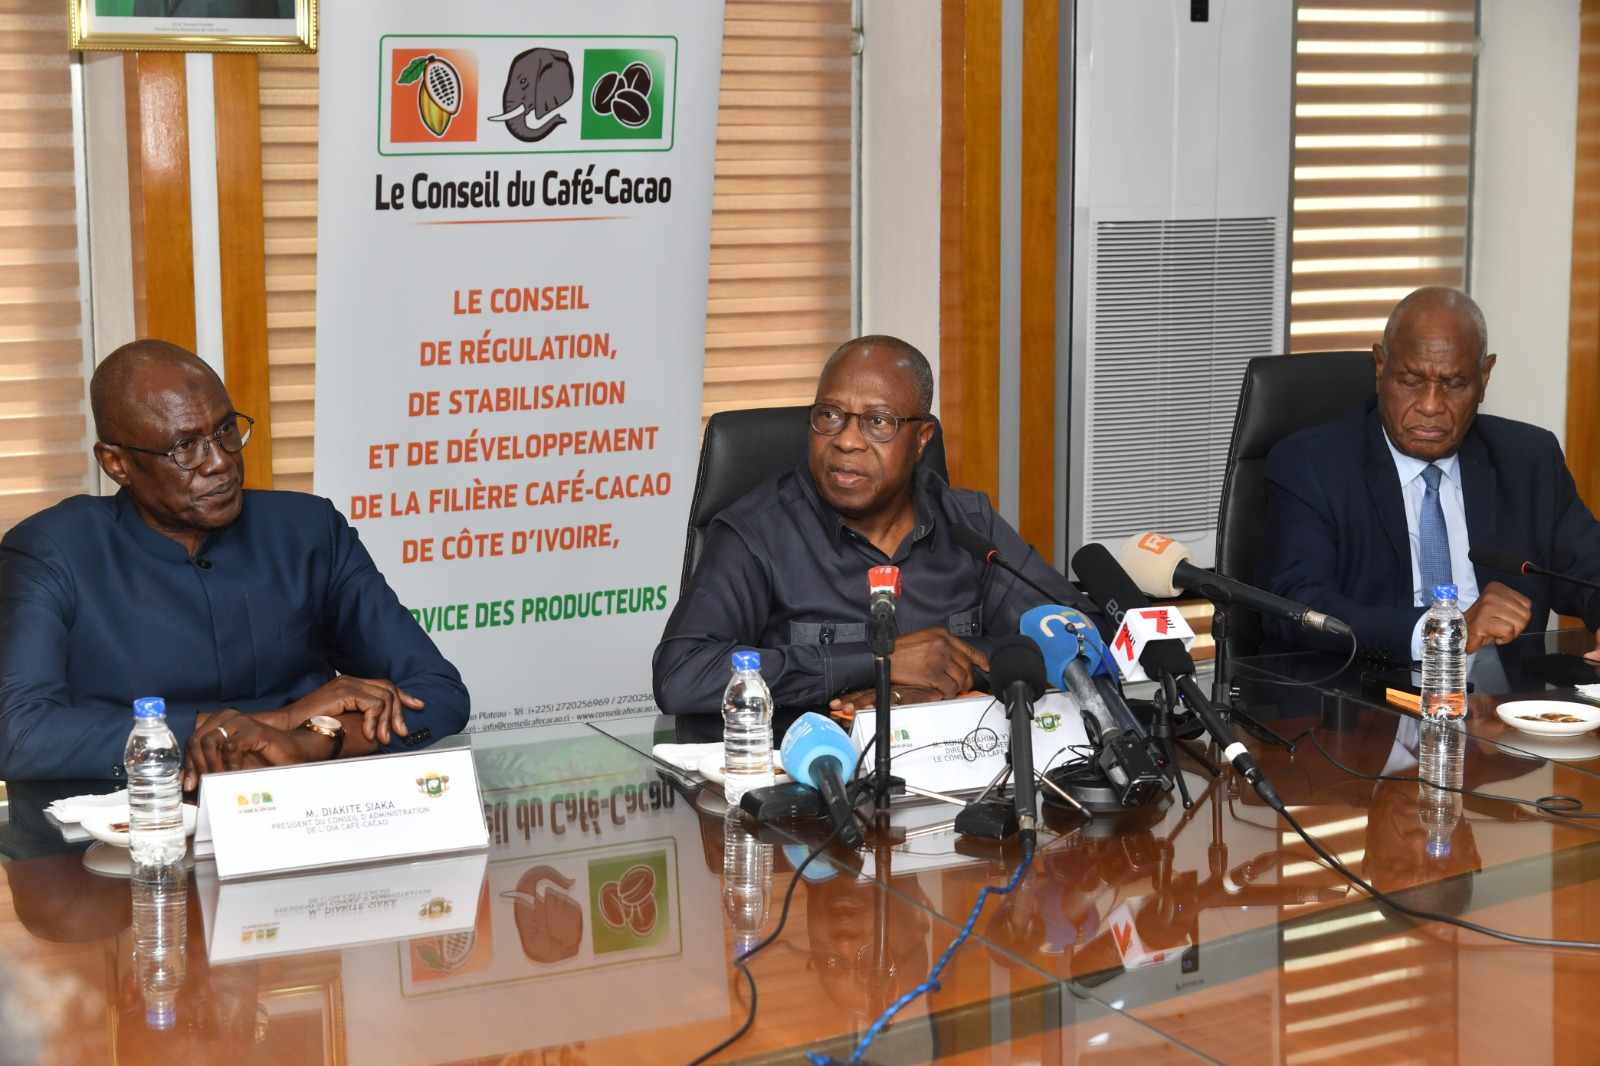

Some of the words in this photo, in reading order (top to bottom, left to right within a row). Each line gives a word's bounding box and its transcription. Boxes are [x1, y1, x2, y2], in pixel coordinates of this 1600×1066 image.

[375, 174, 405, 210] Le
[412, 170, 500, 209] Conseil
[507, 170, 536, 207] du
[542, 164, 672, 206] Café-Cacao
[454, 289, 482, 315] LE
[490, 285, 589, 313] CONSEIL
[420, 341, 452, 366] DE
[460, 329, 617, 364] RÉGULATION,
[408, 391, 440, 417] DE
[448, 380, 625, 415] STABILISATION
[369, 443, 399, 470] ET
[407, 440, 439, 467] DE
[447, 426, 659, 464] DÉVELOPPEMENT
[350, 494, 383, 520] DE
[390, 491, 420, 517] LA
[429, 478, 518, 514] FILIÈRE
[525, 469, 672, 507] CAFÉ-CACAO
[402, 538, 434, 564] DE
[442, 527, 503, 560] CÔTE
[511, 523, 620, 556] D'IVOIRE,
[475, 600, 515, 628] DES
[521, 585, 667, 624] PRODUCTEURS
[479, 710, 507, 720] Plateau
[528, 704, 554, 716] (+225)
[555, 697, 610, 712] 2720256969
[617, 693, 655, 704] 2720256
[272, 819, 312, 831] PRESIDENT
[315, 817, 326, 825] DU
[327, 815, 359, 824] CONSEIL
[306, 810, 318, 818] M.
[322, 803, 362, 817] DIAKITE
[365, 800, 396, 812] SIAKA
[306, 826, 317, 834] DE
